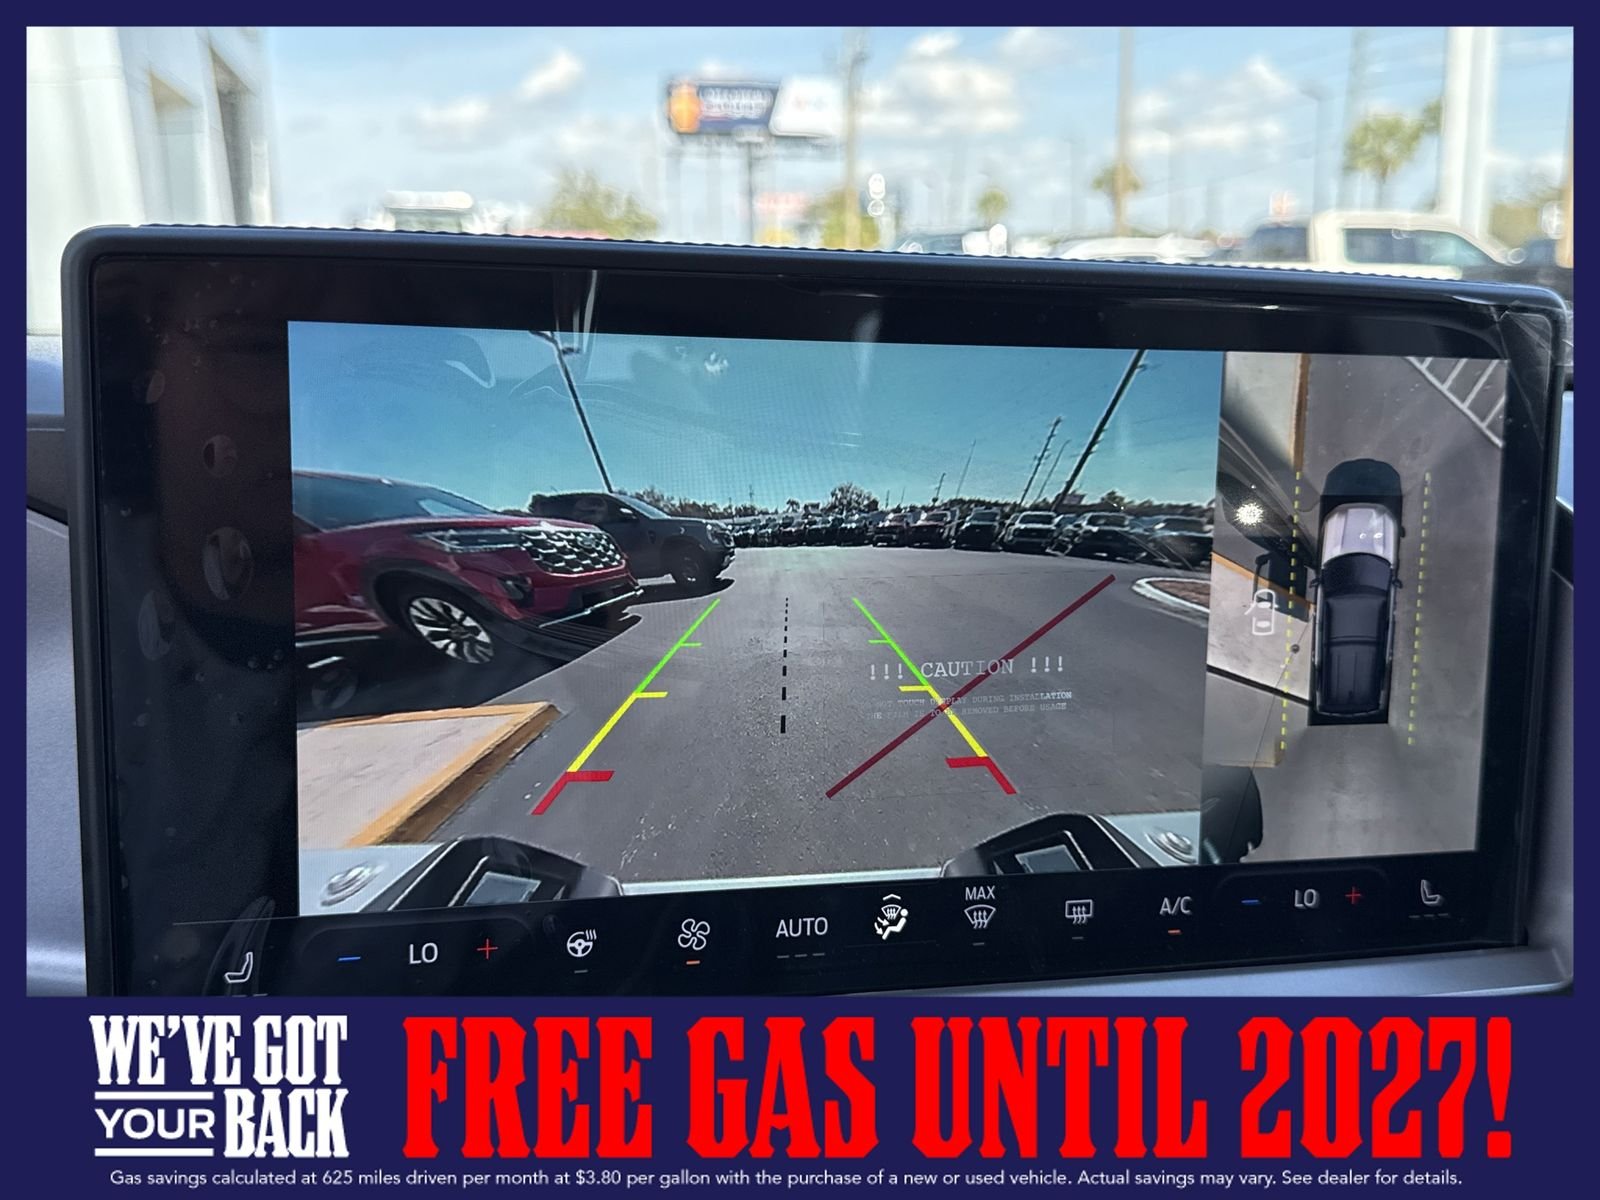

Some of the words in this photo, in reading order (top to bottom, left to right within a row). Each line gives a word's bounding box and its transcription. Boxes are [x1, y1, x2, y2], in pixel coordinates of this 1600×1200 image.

[869, 663, 904, 681] !!!
[920, 658, 1015, 678] CAUTION
[1030, 655, 1064, 673] !!!
[972, 694, 1005, 704] DURING
[1009, 691, 1073, 702] INSTALLATION
[961, 706, 1000, 715] REMOVED
[1003, 703, 1036, 713] BEFORE
[1039, 702, 1068, 711] USAGE
[965, 885, 996, 901] MAX
[1294, 888, 1318, 908] LO
[1159, 896, 1192, 915] A/C
[775, 916, 829, 938] AUTO
[409, 942, 439, 965] LO
